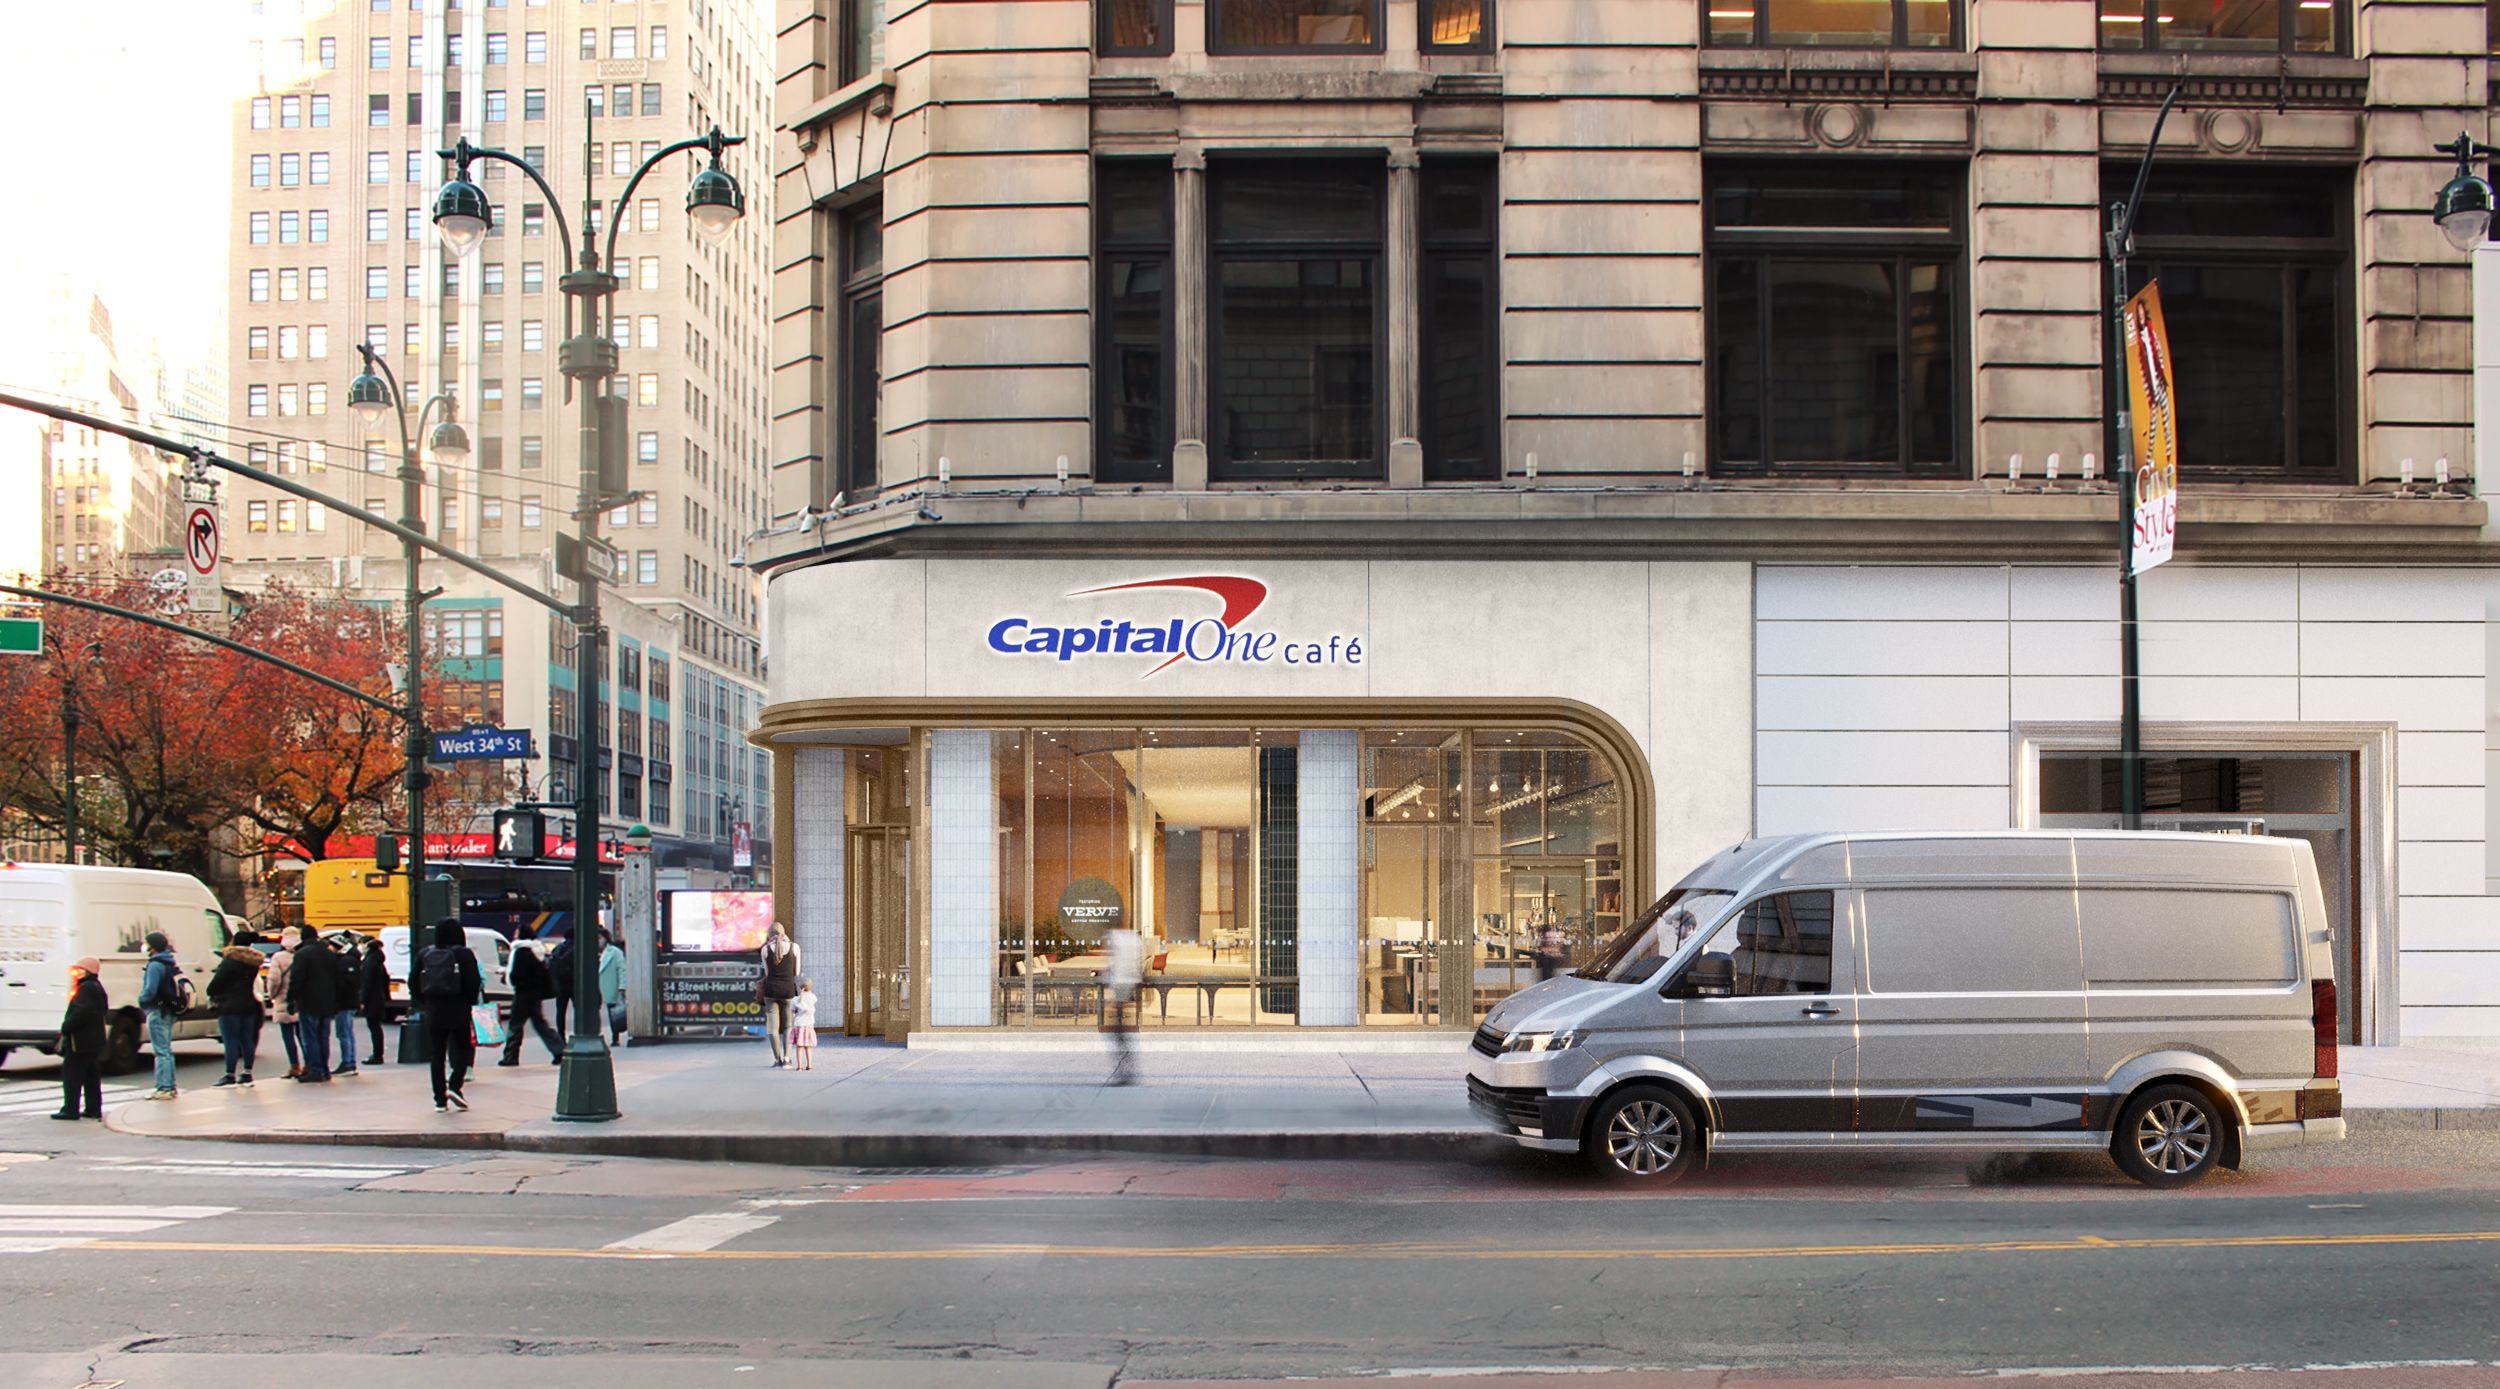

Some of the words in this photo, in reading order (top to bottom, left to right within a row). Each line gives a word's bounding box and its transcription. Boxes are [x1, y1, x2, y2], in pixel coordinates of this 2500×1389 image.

[2133, 495, 2176, 553] Style
[1284, 636, 1362, 664] café
[440, 739, 475, 754] West
[478, 737, 504, 752] 34th
[507, 737, 522, 752] St
[1062, 906, 1119, 917] VERVE
[663, 982, 675, 991] 34
[678, 981, 746, 991] Street-Herald
[663, 992, 700, 1001] Station
